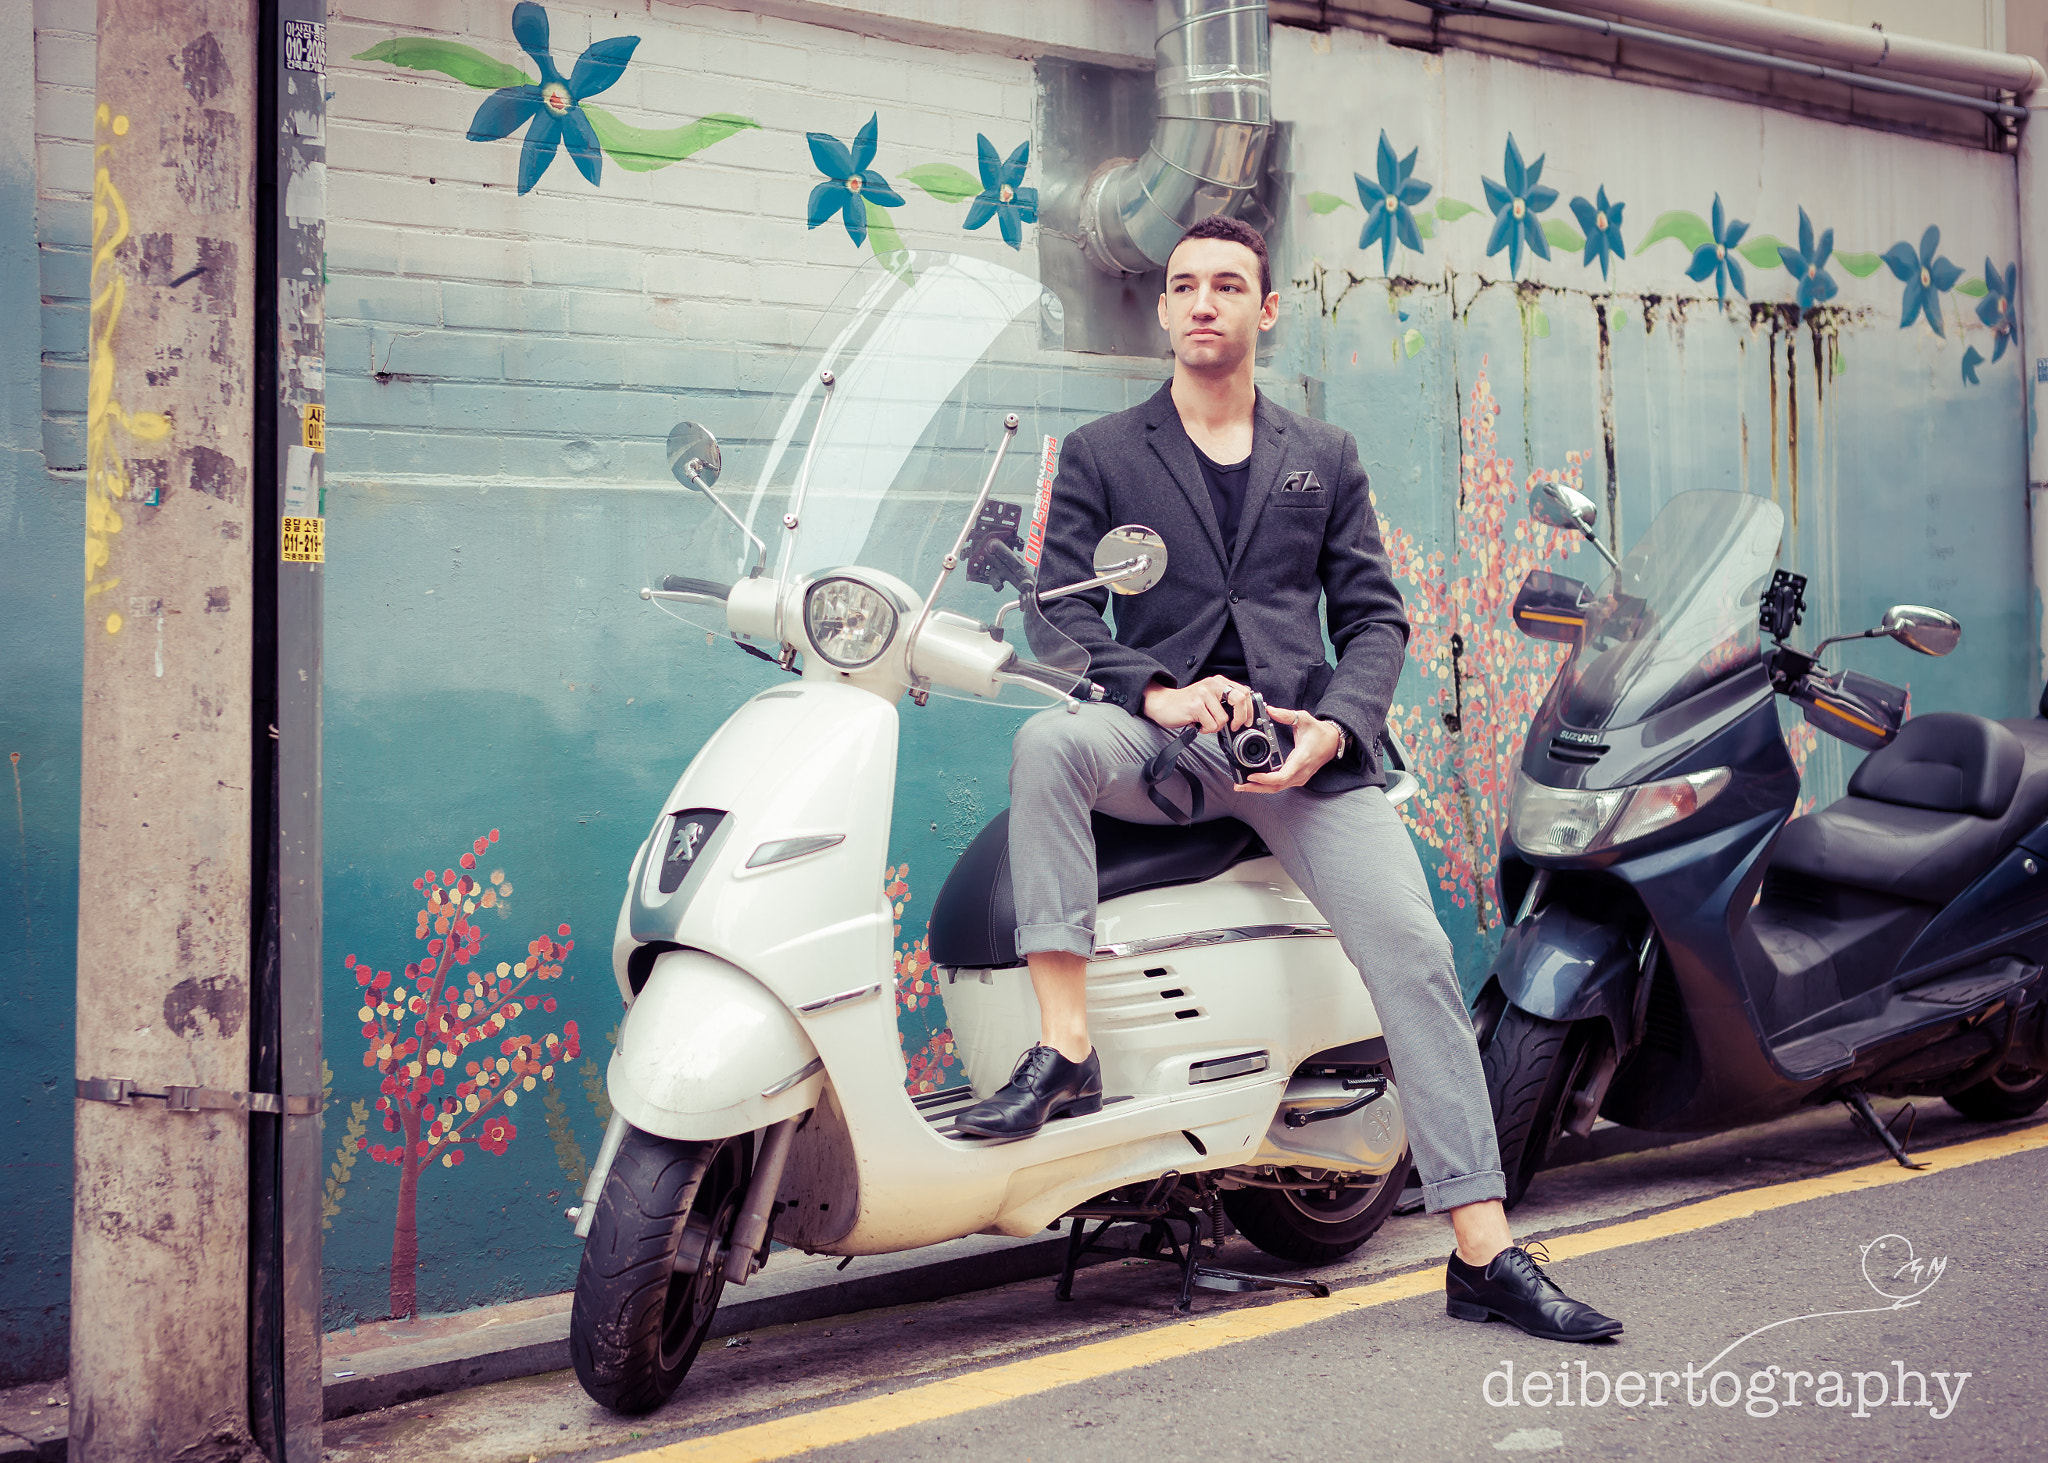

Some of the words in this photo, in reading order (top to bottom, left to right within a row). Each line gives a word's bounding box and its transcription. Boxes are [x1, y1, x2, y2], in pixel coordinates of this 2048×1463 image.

[1025, 520, 1045, 567] 010
[1038, 436, 1058, 525] 2695-0714
[284, 518, 301, 533] 용달
[1559, 730, 1598, 744] SUZUKI
